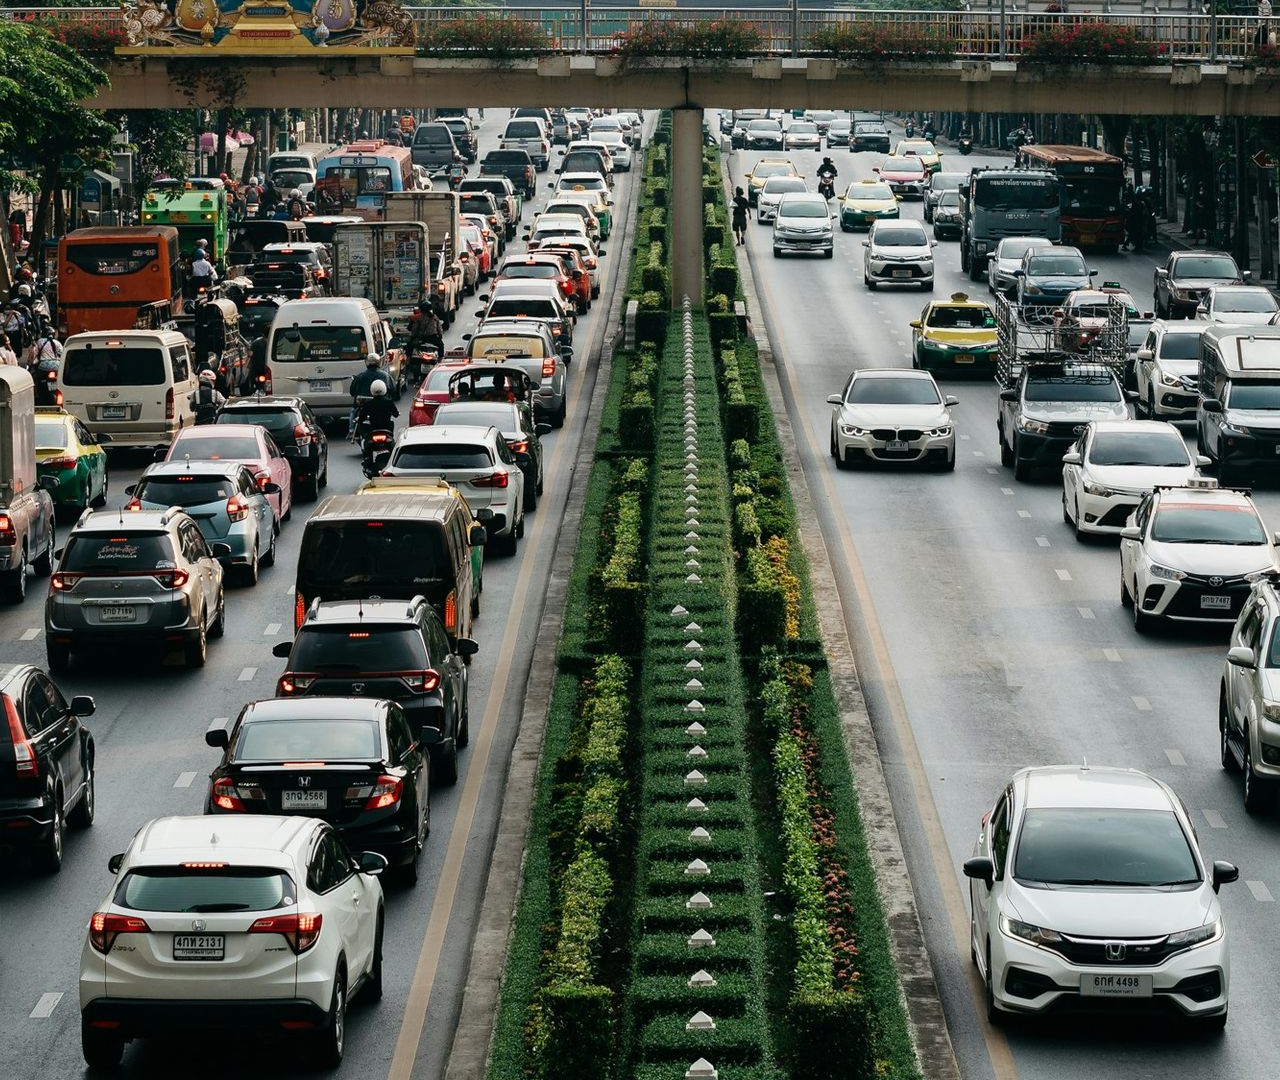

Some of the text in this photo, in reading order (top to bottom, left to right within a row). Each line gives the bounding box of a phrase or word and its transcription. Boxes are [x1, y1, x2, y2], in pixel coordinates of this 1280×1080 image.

[304, 791, 324, 801] 2566
[198, 937, 222, 948] 2131
[1116, 976, 1139, 988] 4498
